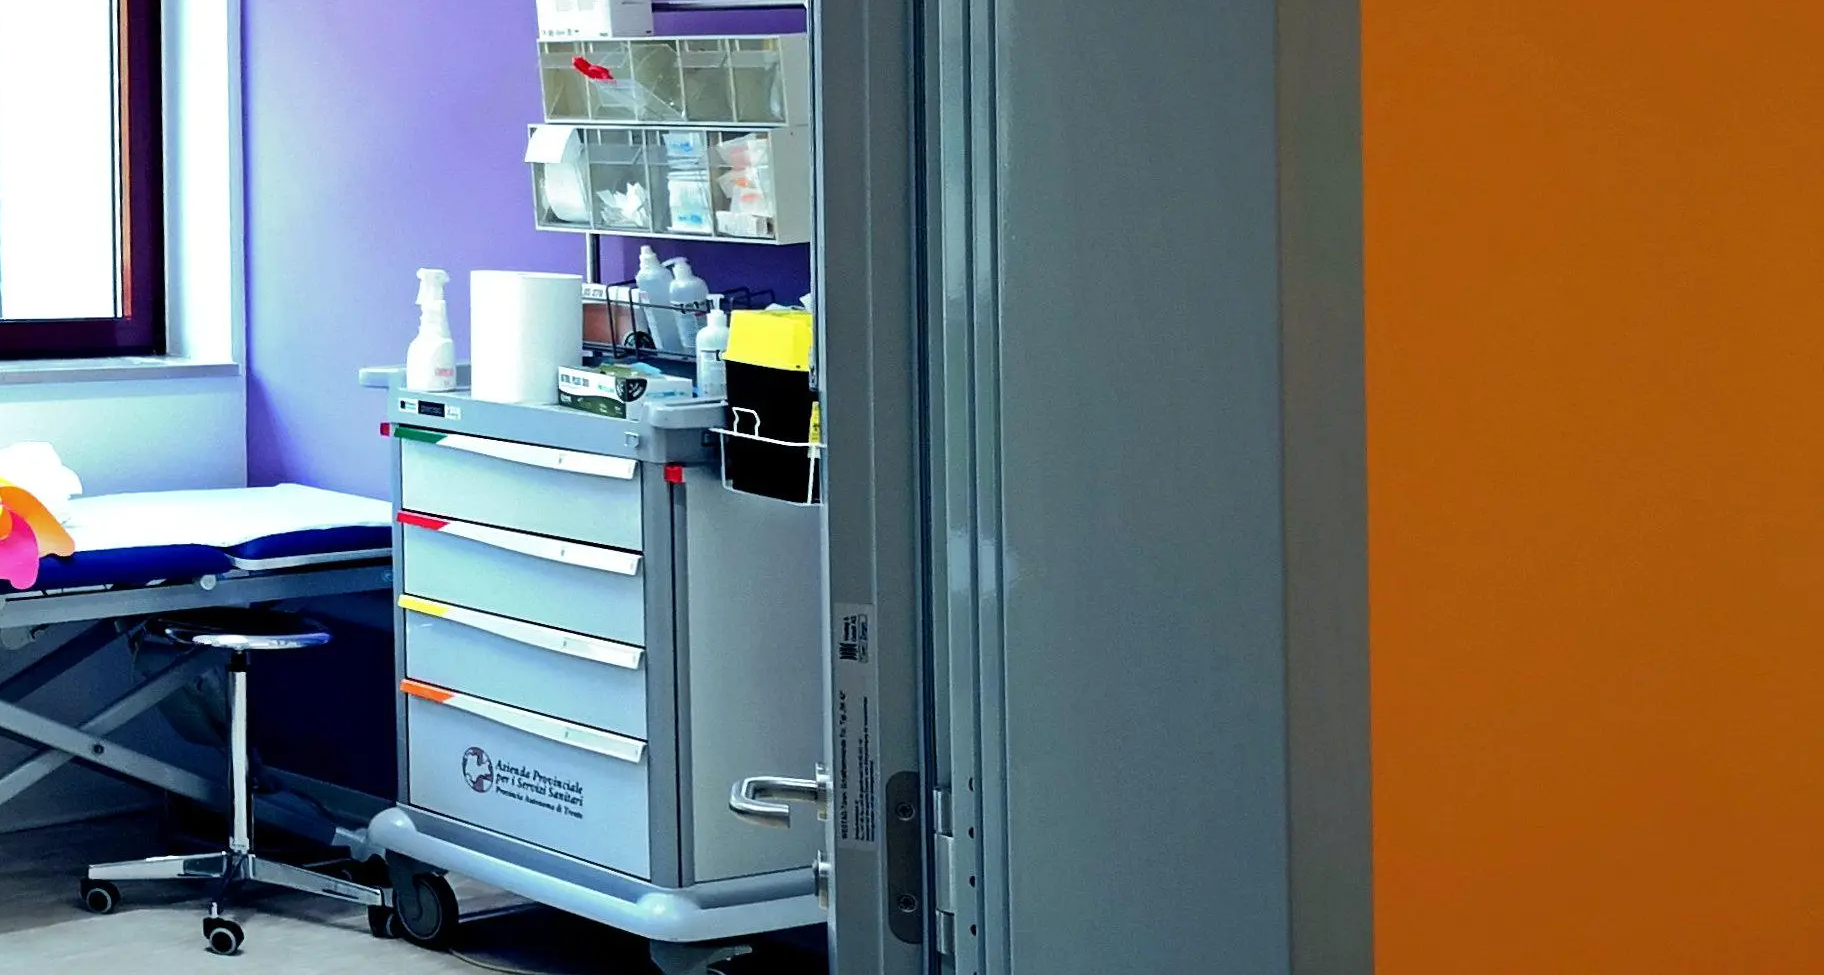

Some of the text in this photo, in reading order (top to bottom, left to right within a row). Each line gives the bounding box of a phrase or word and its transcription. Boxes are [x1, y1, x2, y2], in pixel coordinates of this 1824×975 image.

[496, 759, 583, 795] Azienda Provinciale
[517, 779, 546, 796] Servizi
[548, 786, 584, 807] Sanitari
